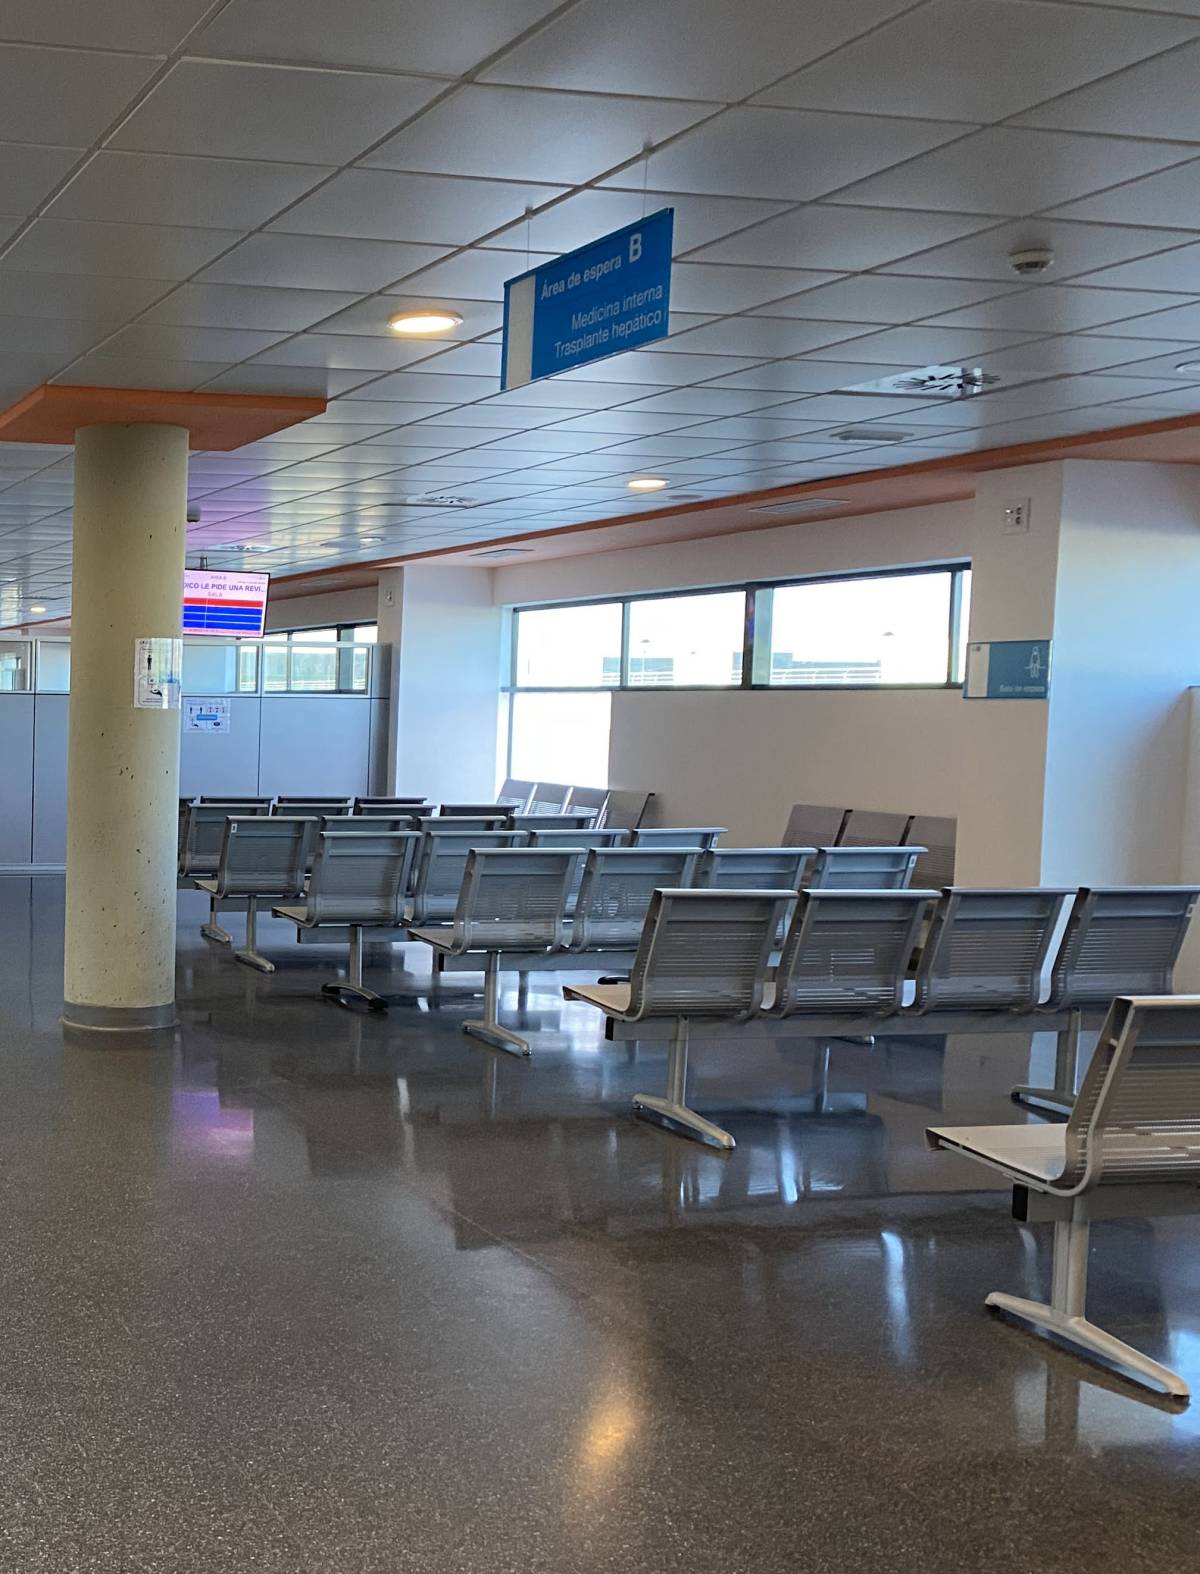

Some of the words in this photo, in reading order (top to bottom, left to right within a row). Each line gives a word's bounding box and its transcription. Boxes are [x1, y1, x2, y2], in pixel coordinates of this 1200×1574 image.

[541, 280, 565, 300] Área
[567, 272, 581, 289] de
[583, 256, 622, 282] espera
[629, 233, 642, 263] B
[572, 302, 620, 330] Medicina
[623, 285, 663, 311] interna
[555, 328, 609, 358] Trasplante
[612, 310, 661, 338] hepático
